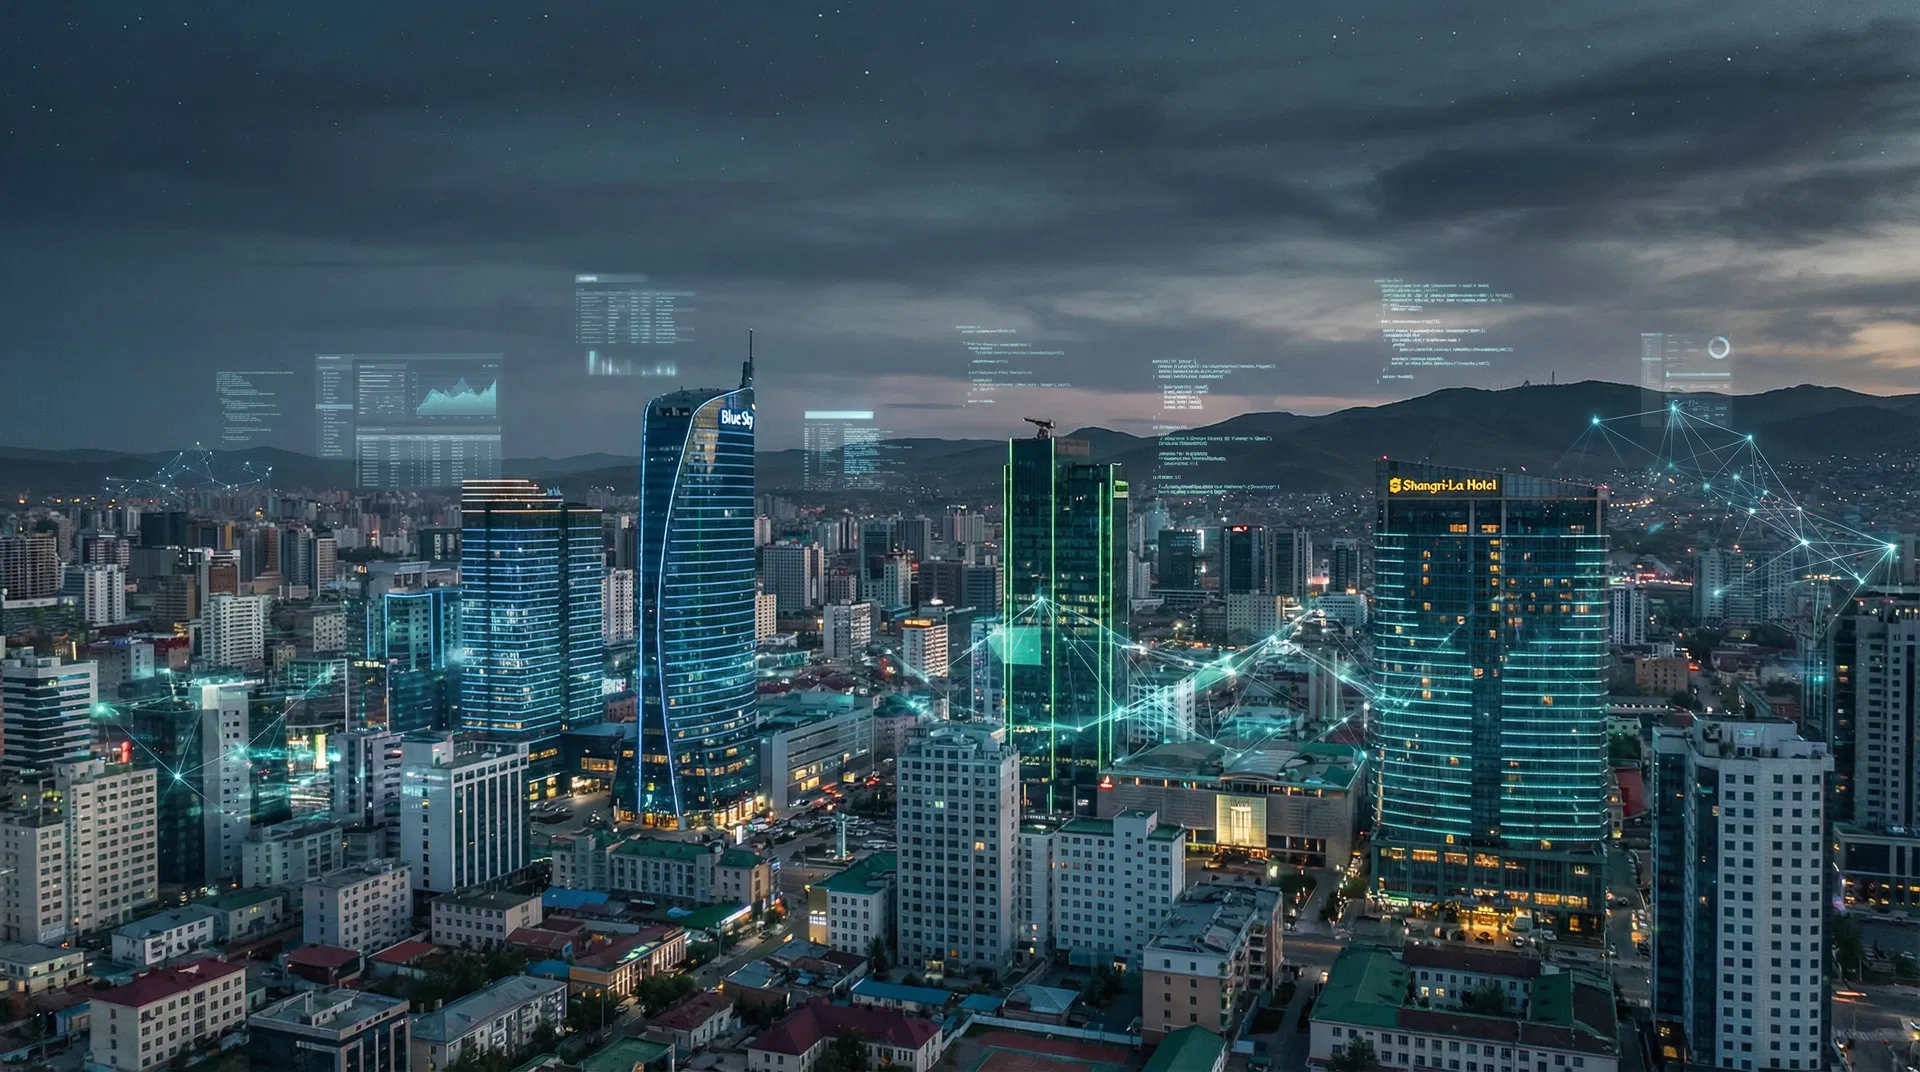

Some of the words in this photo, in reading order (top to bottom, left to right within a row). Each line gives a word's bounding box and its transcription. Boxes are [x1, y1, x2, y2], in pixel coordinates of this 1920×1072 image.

[721, 409, 741, 425] Blue
[1402, 479, 1465, 494] Shangri-La
[1466, 479, 1497, 491] Hotel
